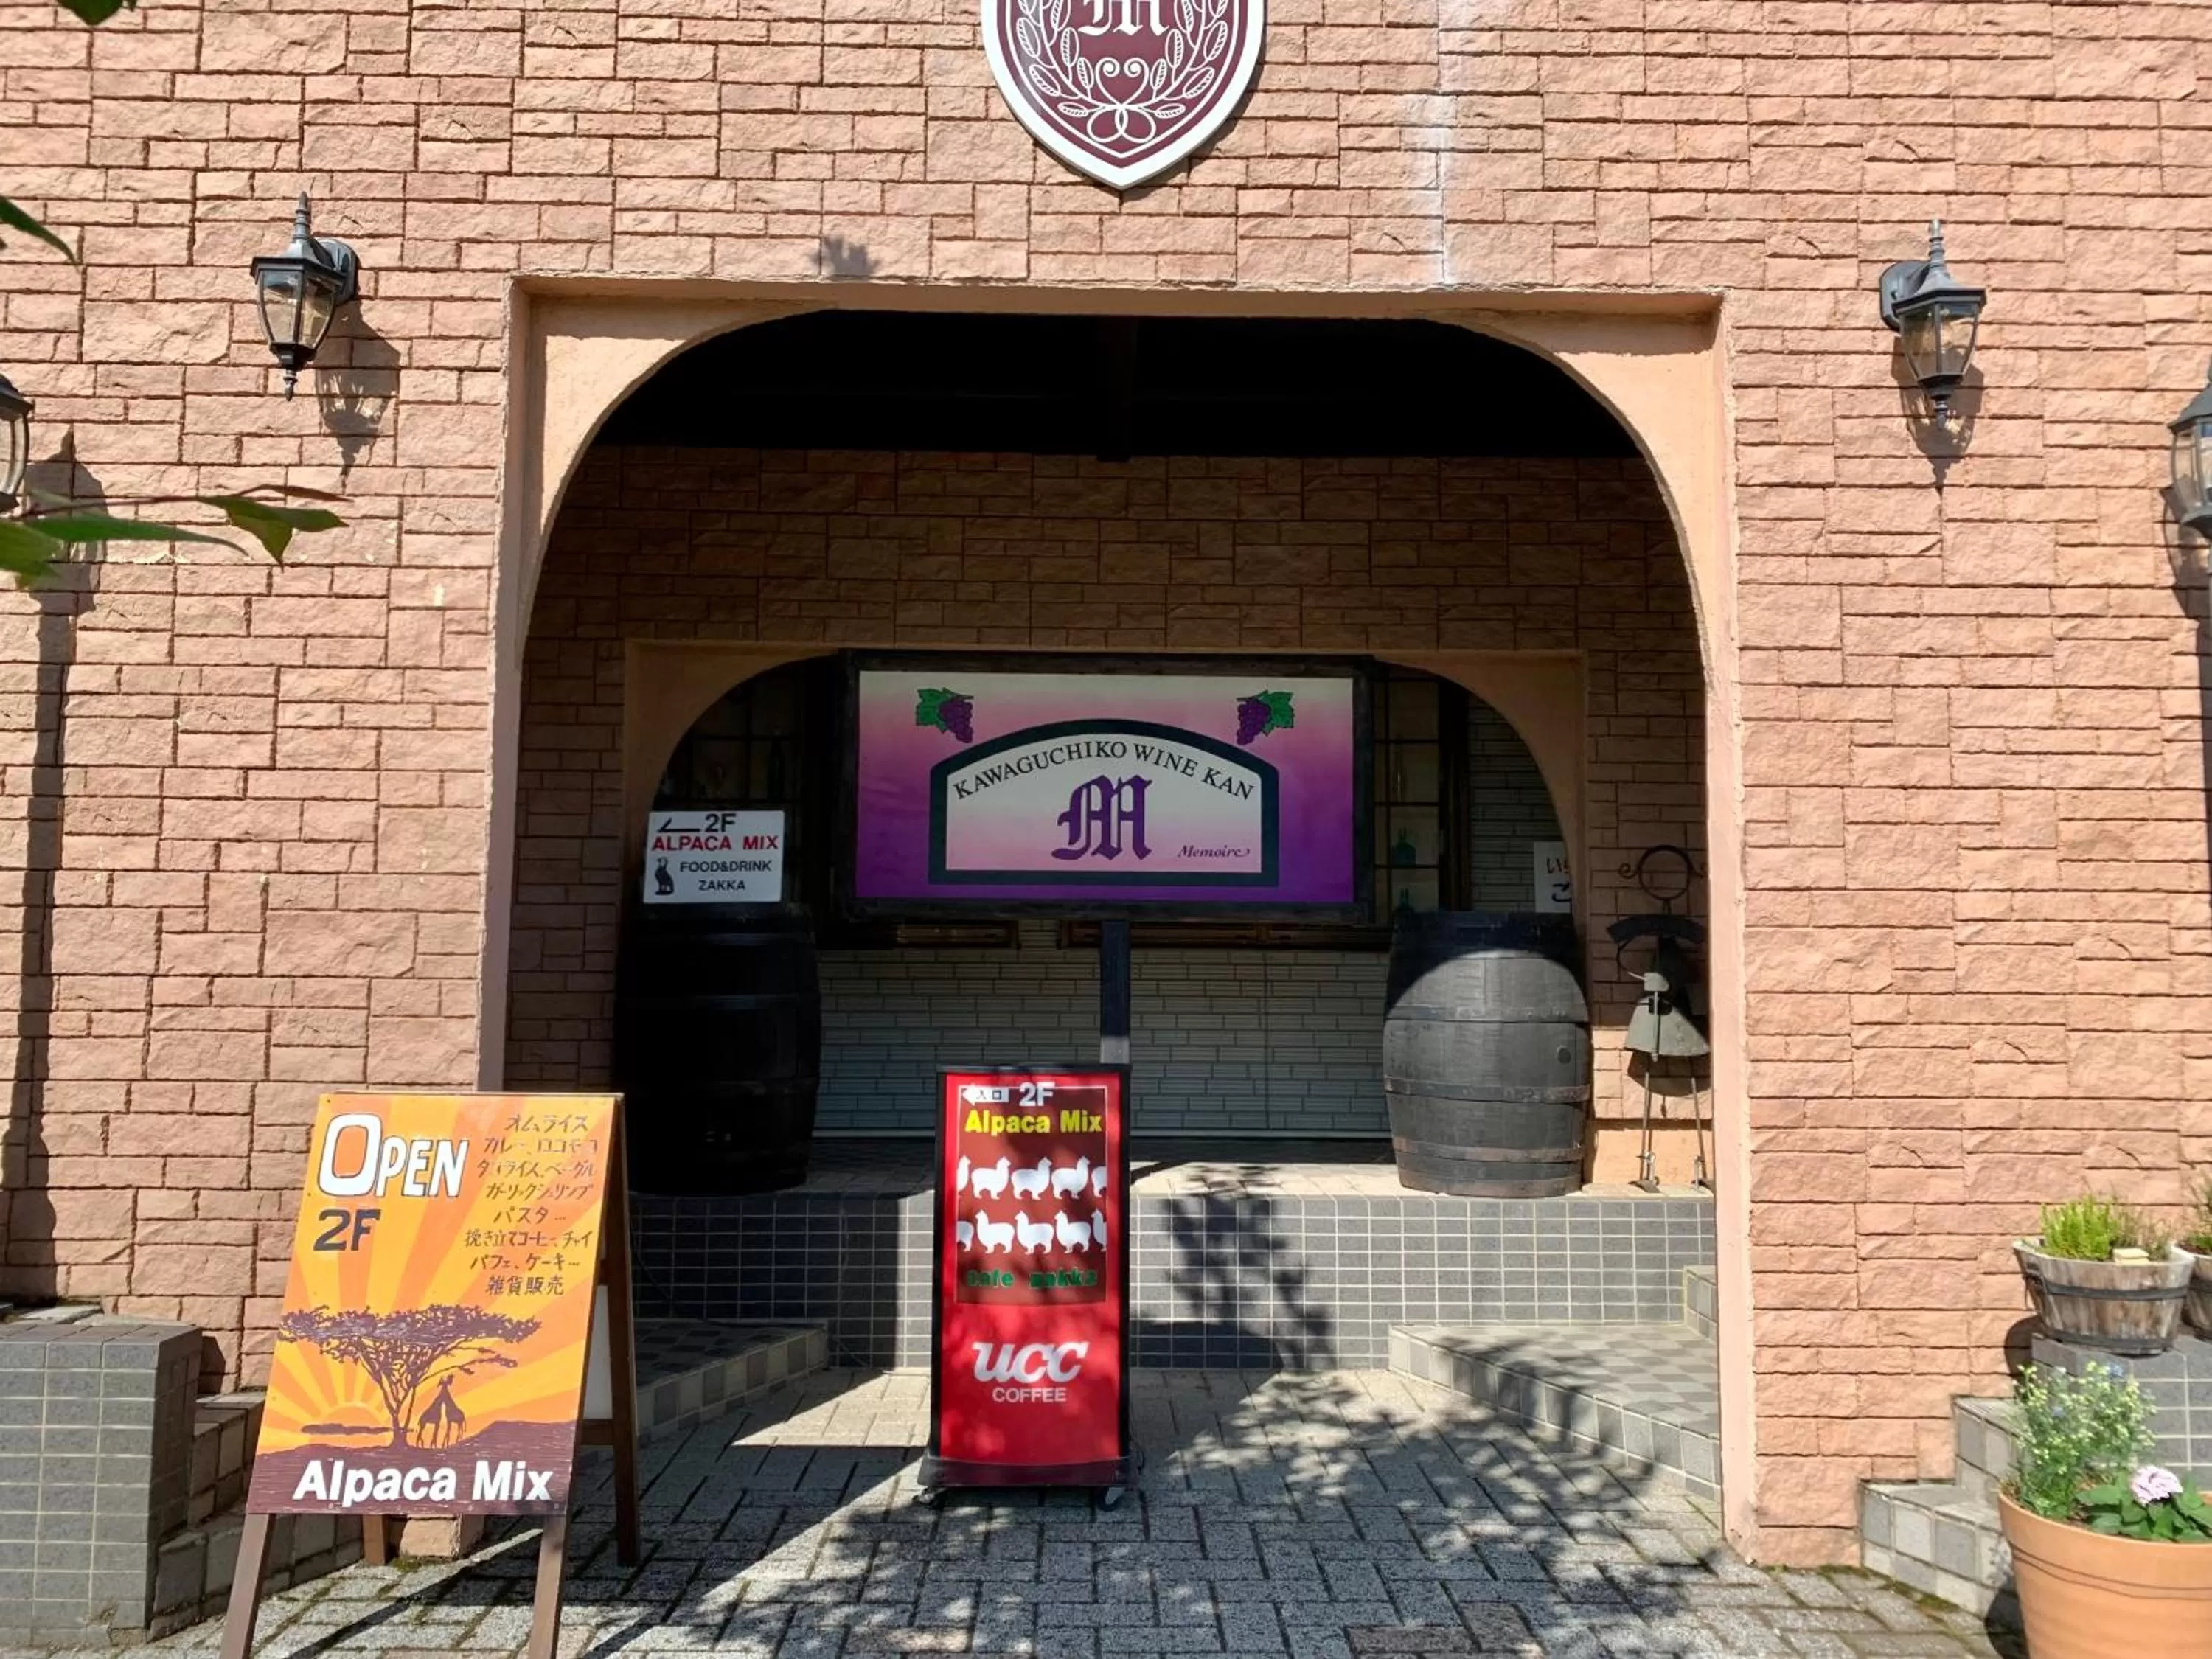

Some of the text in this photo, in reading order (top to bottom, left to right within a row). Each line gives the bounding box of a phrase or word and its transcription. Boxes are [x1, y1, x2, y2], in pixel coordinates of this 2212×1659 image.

[952, 741, 1255, 800] KAWAGUCHIKO WINE KAN
[704, 813, 737, 833] 2F
[1051, 774, 1152, 861] M
[651, 835, 779, 851] ALPACA MIX
[1177, 844, 1251, 858] Memoire
[680, 860, 773, 872] FOOD&DRINK
[698, 880, 745, 891] ZAKKA
[975, 1089, 1002, 1101] 入口
[1018, 1081, 1056, 1107] 2F
[964, 1110, 1103, 1136] Alpaca Mix
[318, 1113, 470, 1198] OPEN
[313, 1208, 382, 1251] 2F
[485, 1274, 564, 1296] 雑貨販売
[992, 1387, 1068, 1402] COFFEE
[292, 1459, 554, 1507] Alpaca Mix
